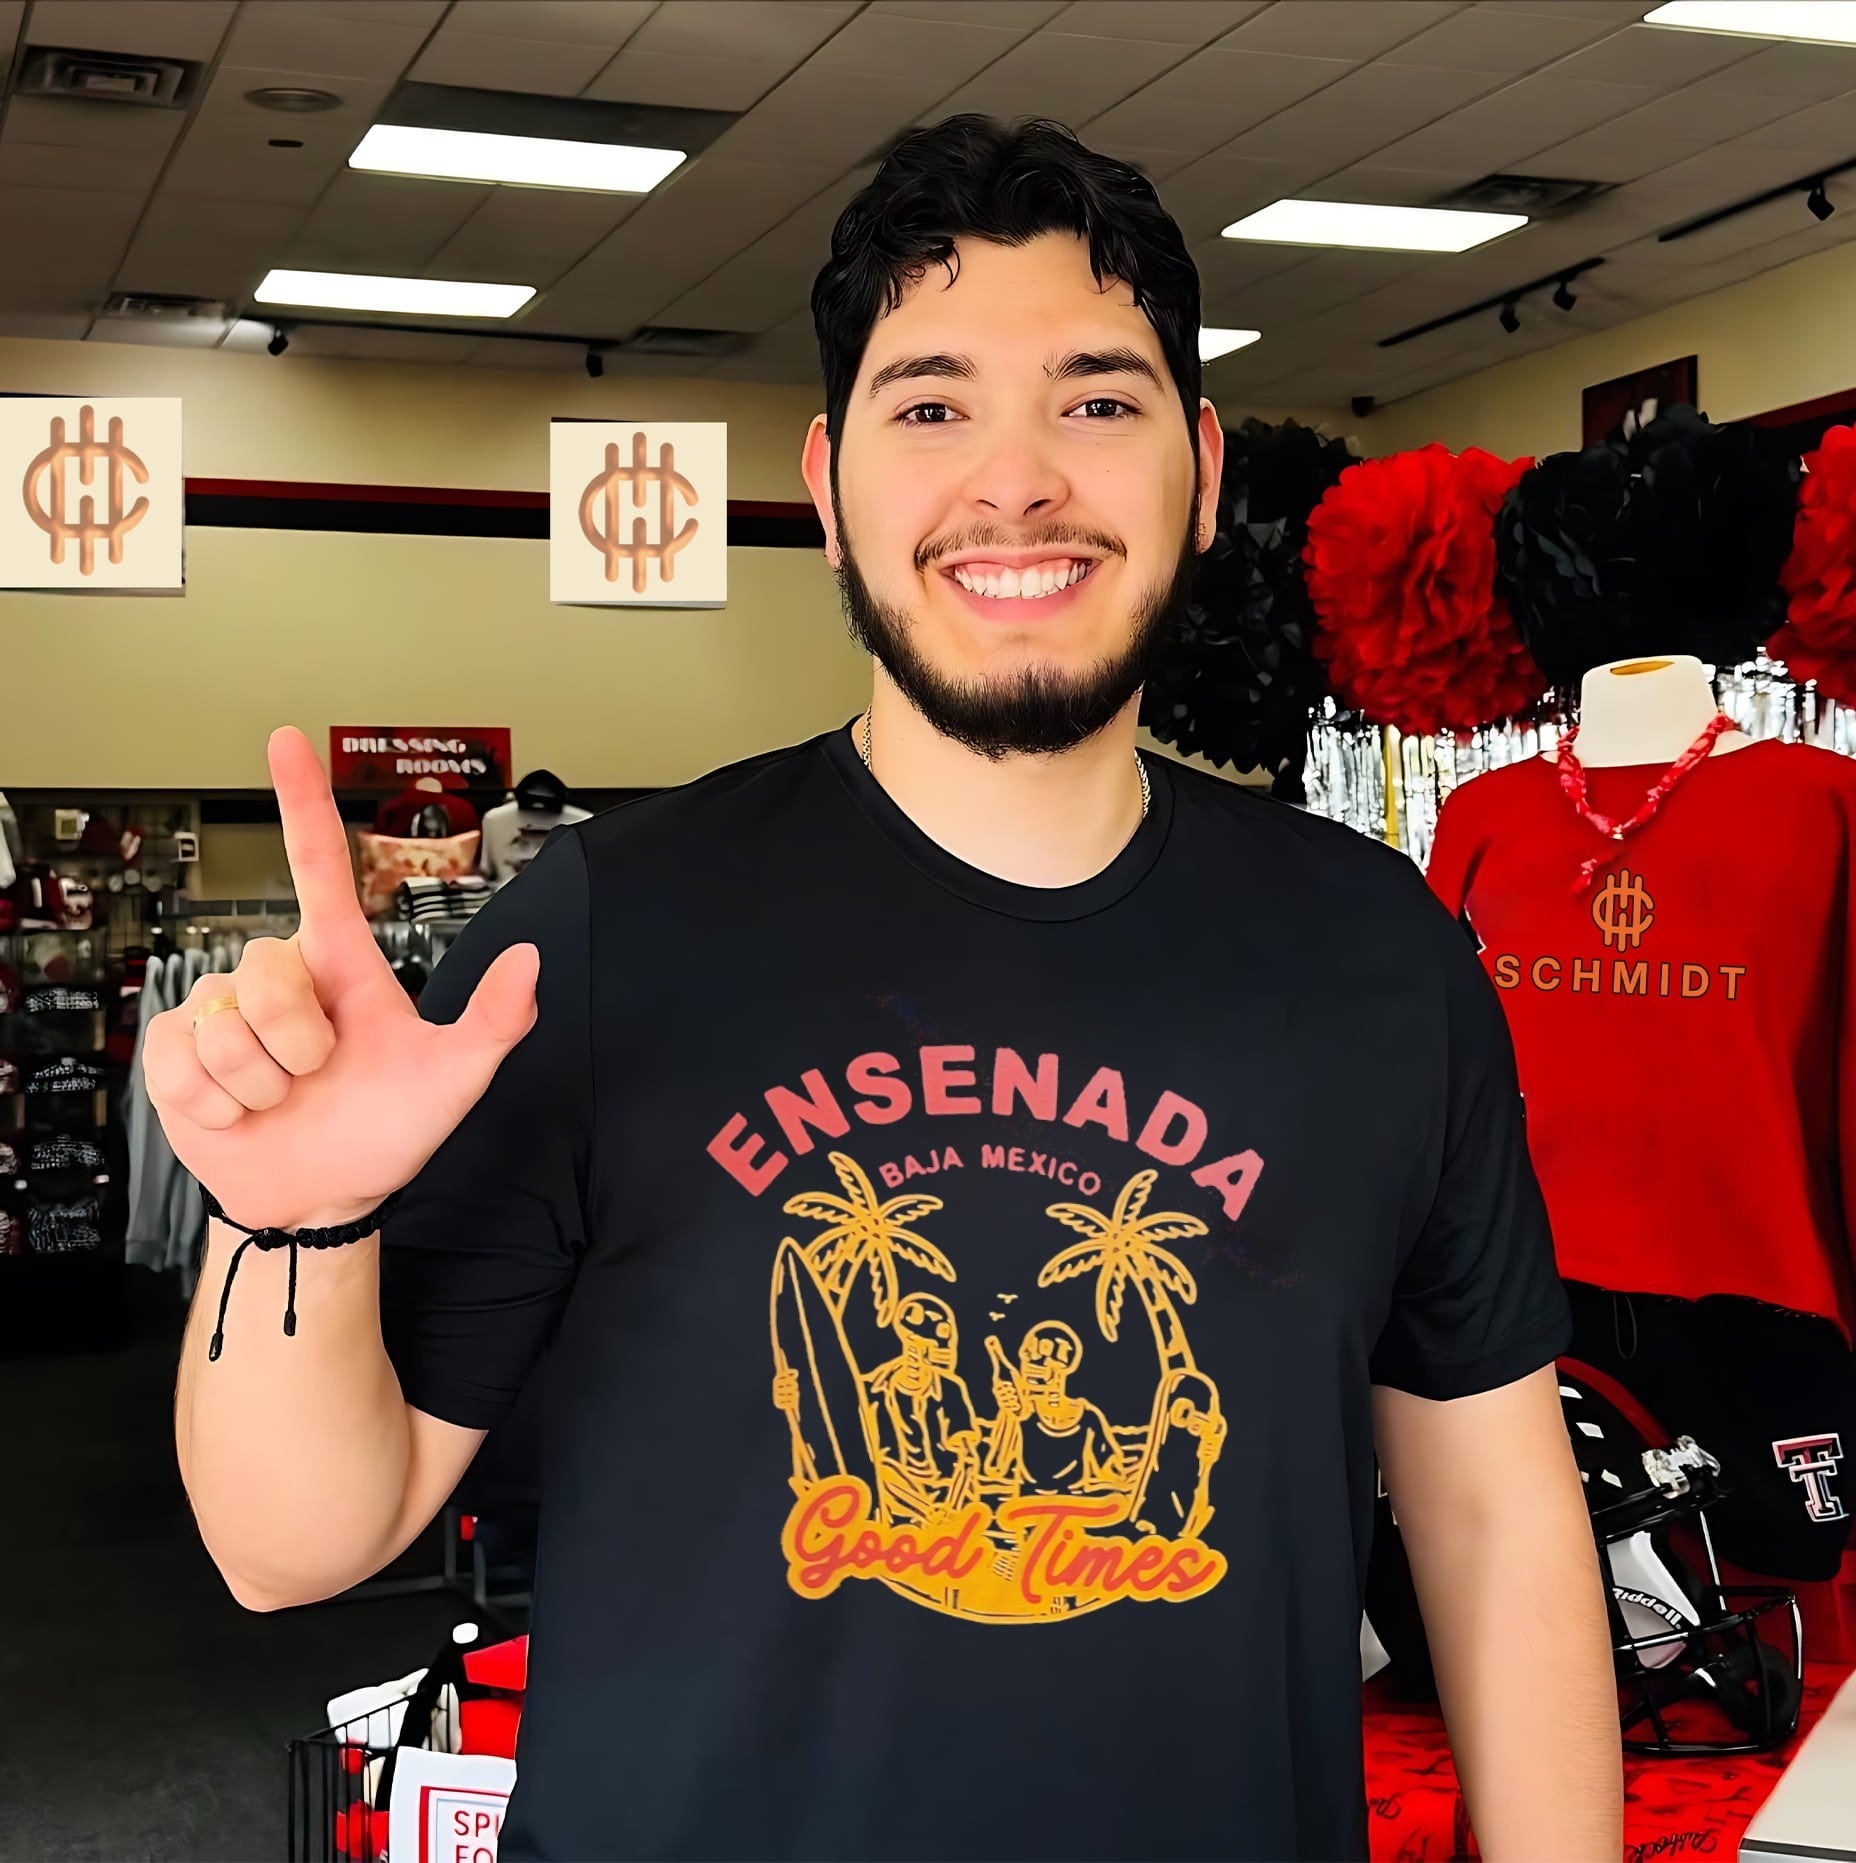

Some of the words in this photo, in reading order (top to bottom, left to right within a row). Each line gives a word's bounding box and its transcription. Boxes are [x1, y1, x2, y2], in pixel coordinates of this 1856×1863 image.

[342, 737, 467, 754] DRESSING
[396, 758, 487, 775] ROOMS
[1494, 954, 1747, 1000] SCHMIDT
[706, 1045, 1265, 1222] ENSENADA
[879, 1146, 965, 1188] BAJA
[981, 1144, 1101, 1196] MEXICO
[794, 1485, 984, 1589] Good
[1008, 1503, 1217, 1604] Times
[1612, 1587, 1682, 1626] Riddell
